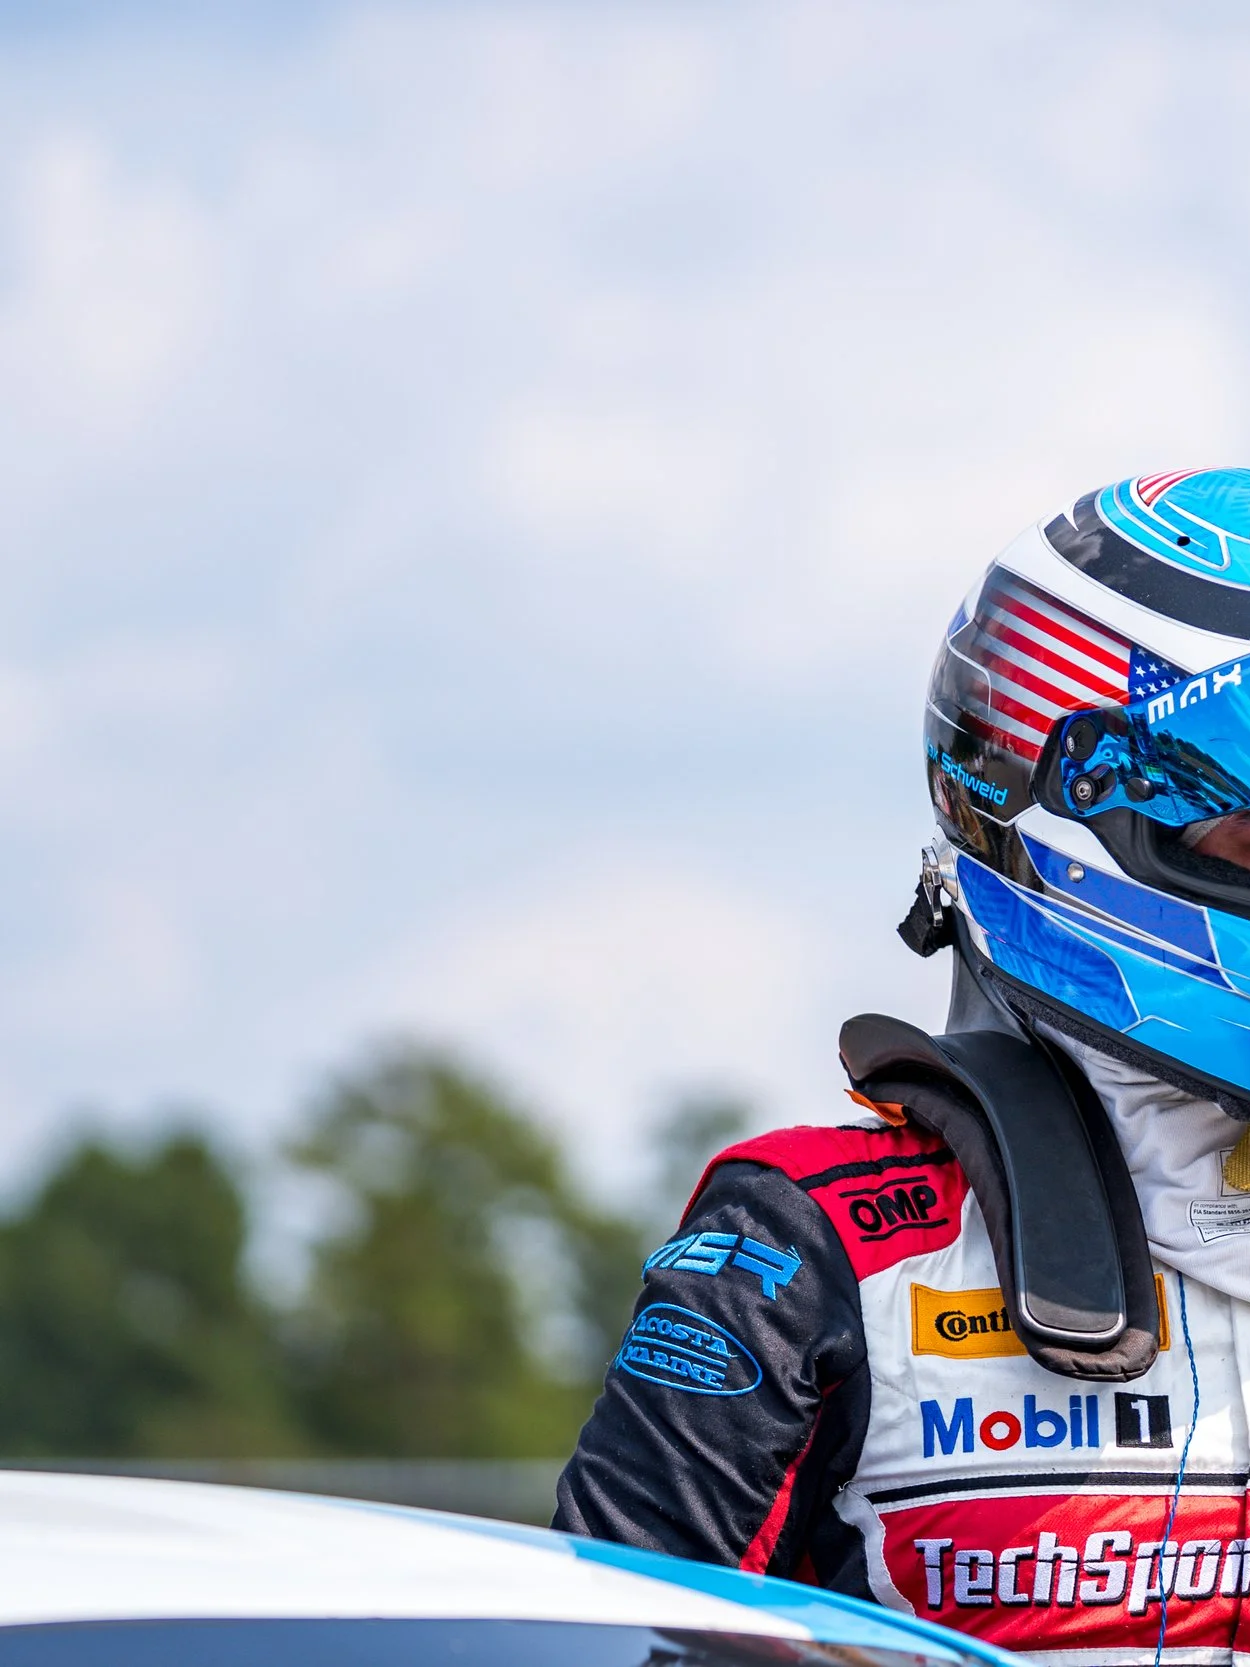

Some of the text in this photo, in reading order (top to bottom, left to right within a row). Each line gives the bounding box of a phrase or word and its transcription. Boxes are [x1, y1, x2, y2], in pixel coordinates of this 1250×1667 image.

[1148, 663, 1242, 725] MAX
[941, 752, 1008, 806] Schweid
[850, 1185, 937, 1232] OMP
[934, 1307, 1012, 1341] Conti
[920, 1394, 1100, 1458] Mobil
